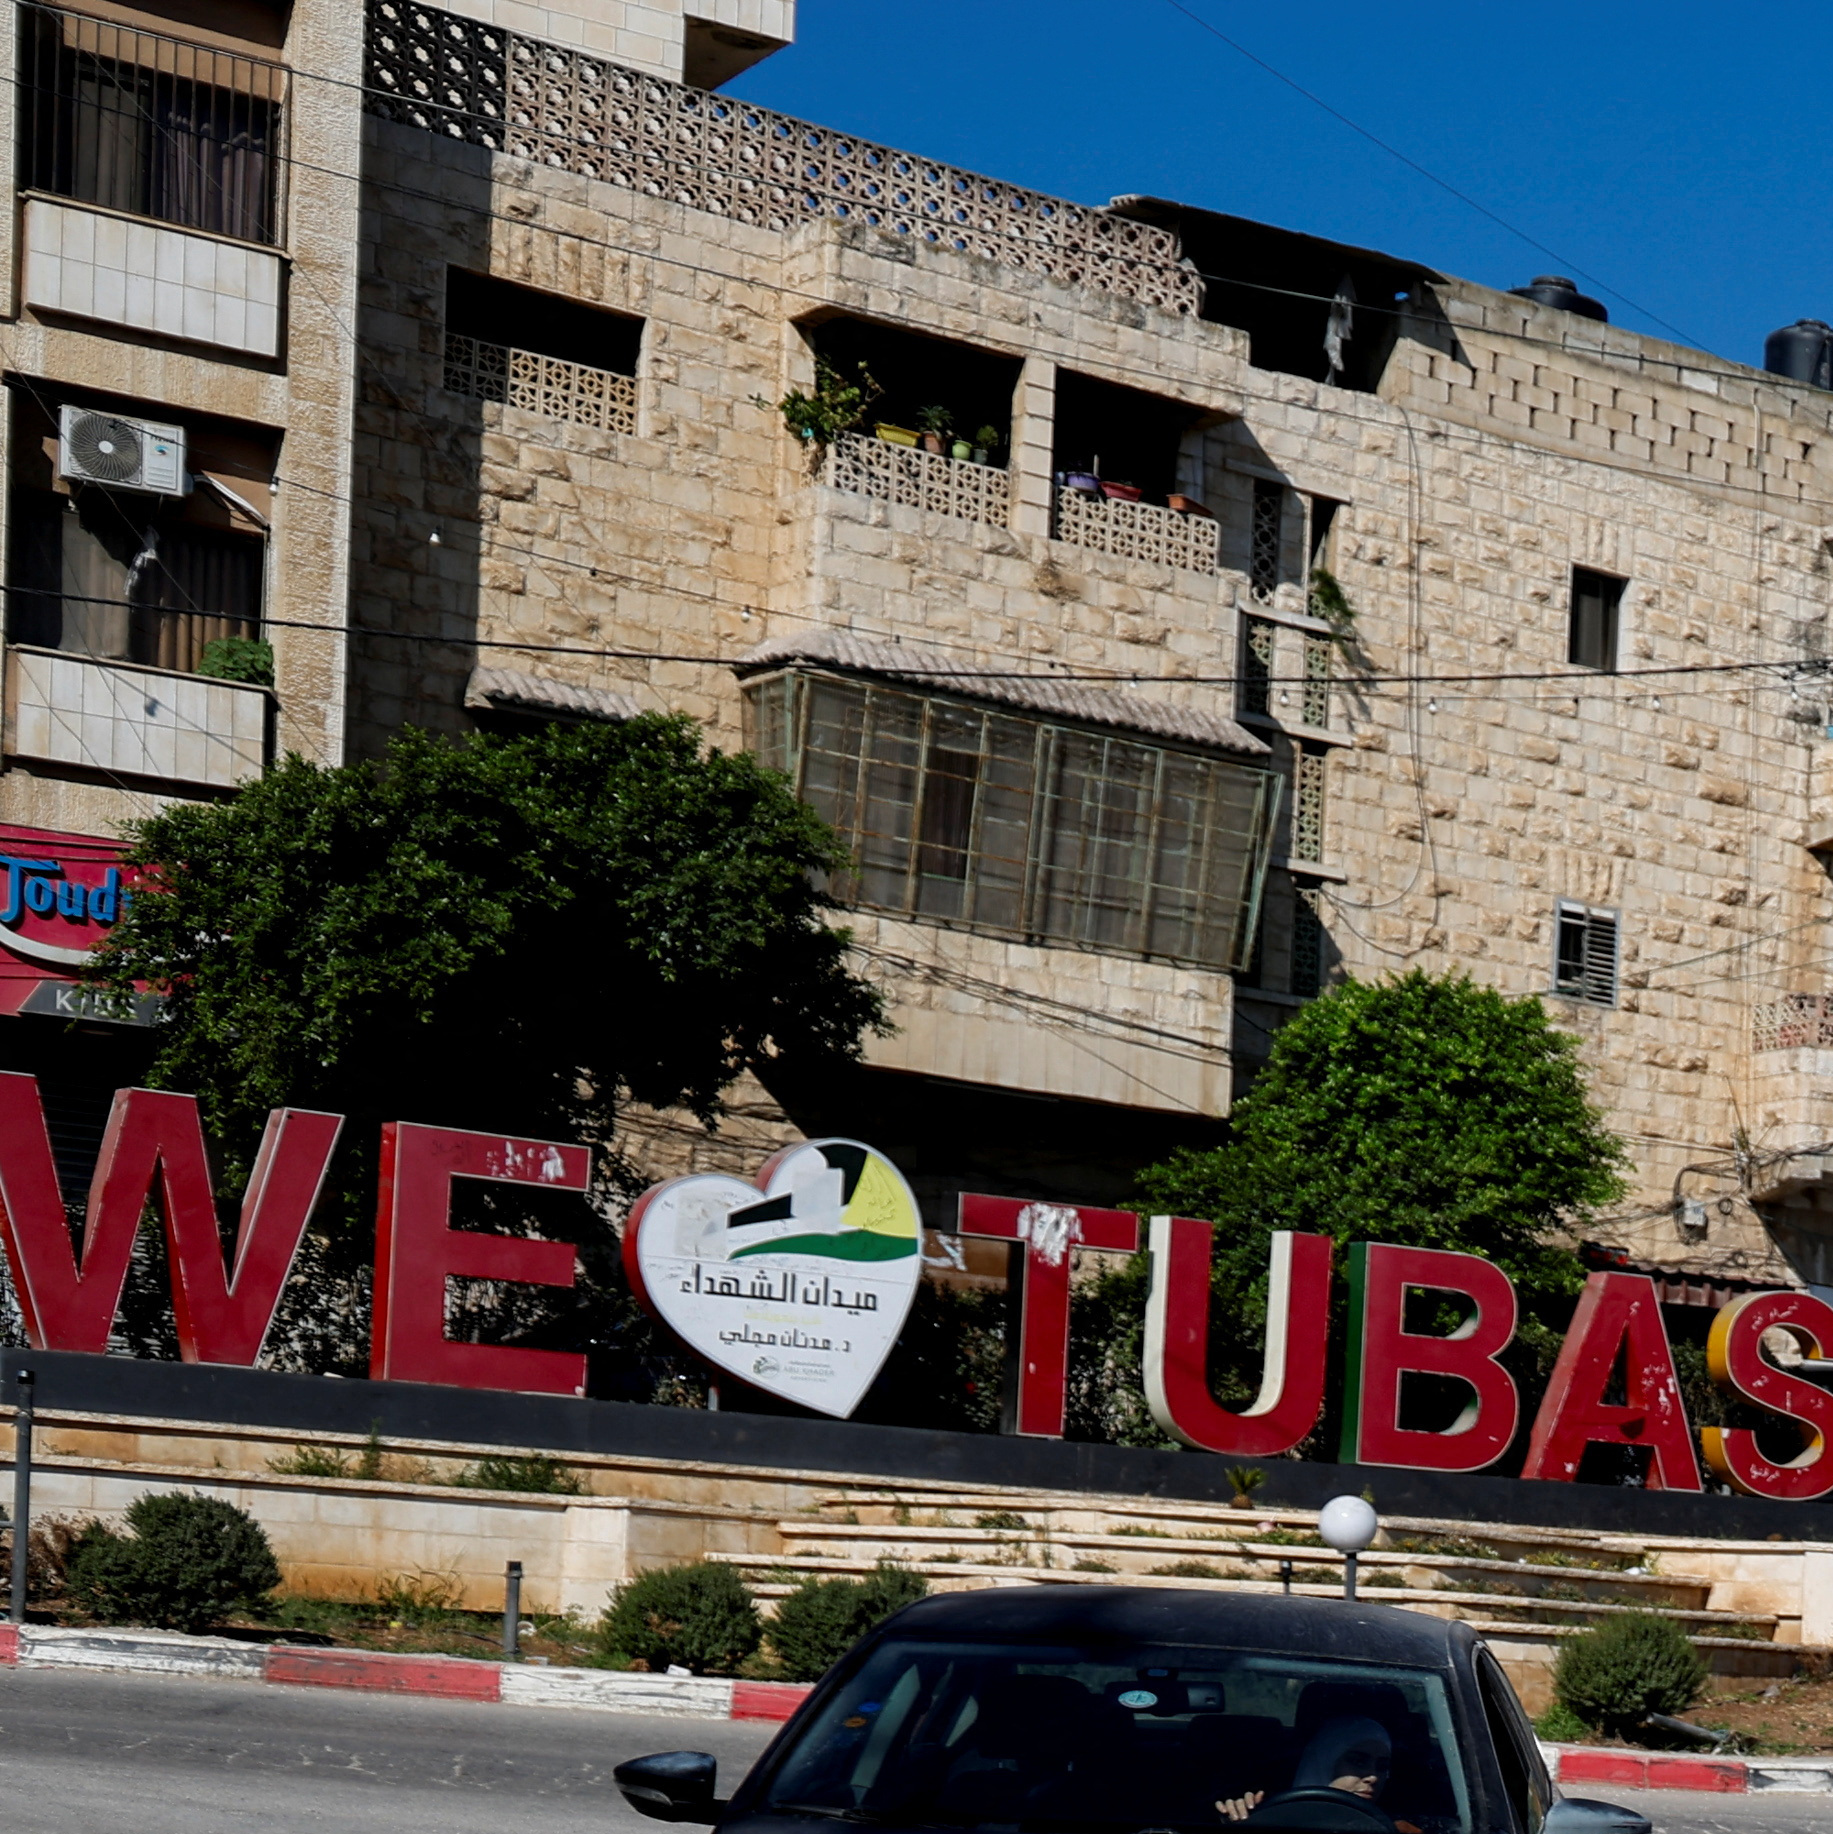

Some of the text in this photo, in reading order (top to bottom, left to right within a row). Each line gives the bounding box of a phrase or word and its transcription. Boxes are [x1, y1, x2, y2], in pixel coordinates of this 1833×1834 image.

[0, 1070, 592, 1397] WE
[679, 1263, 878, 1315] ميدان الشهداء
[719, 1323, 776, 1348] مجلي
[780, 1328, 832, 1352] عدنان
